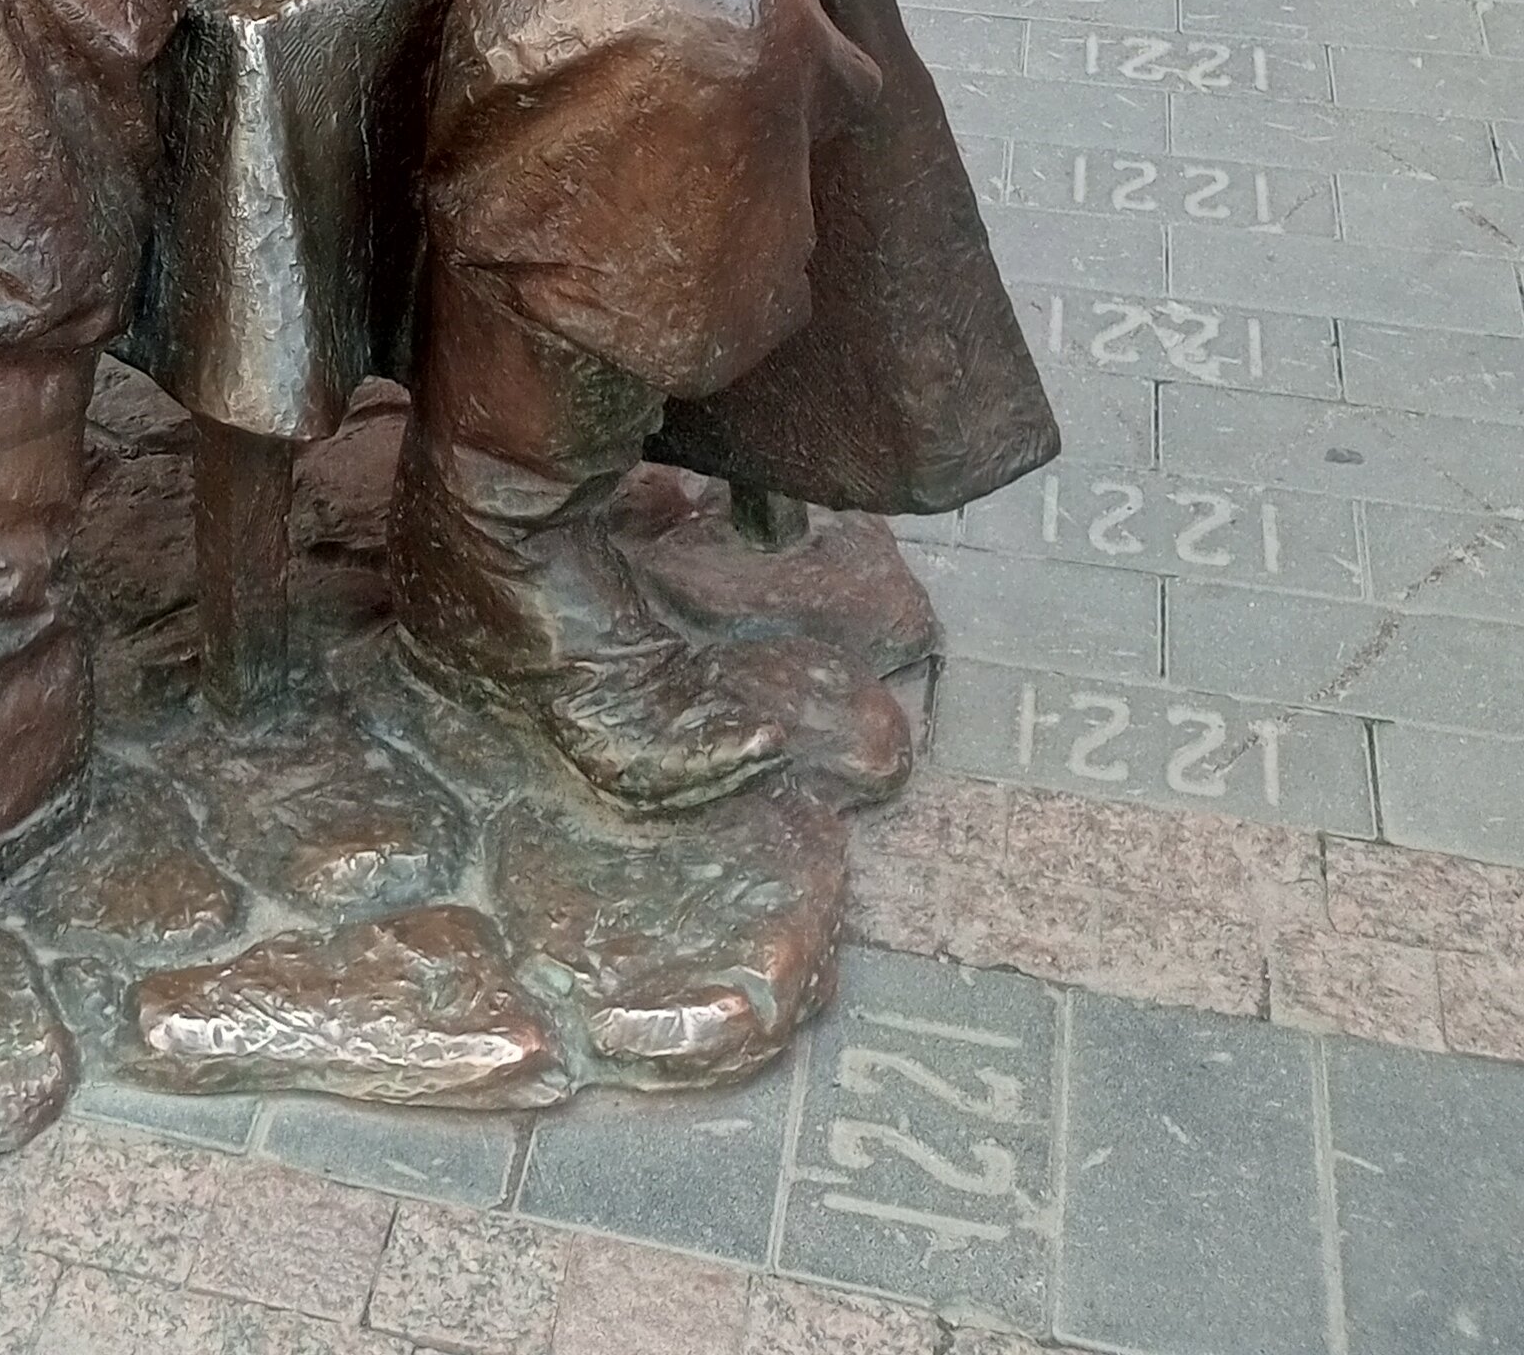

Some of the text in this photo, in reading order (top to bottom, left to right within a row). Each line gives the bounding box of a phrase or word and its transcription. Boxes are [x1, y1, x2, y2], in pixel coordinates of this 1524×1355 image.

[1085, 34, 1269, 91] 1221
[1073, 156, 1270, 222] 1221
[1048, 295, 1264, 381] 1221
[1042, 475, 1280, 573] 1221
[1018, 684, 1284, 806] 1221
[822, 1005, 1024, 1241] 1221
